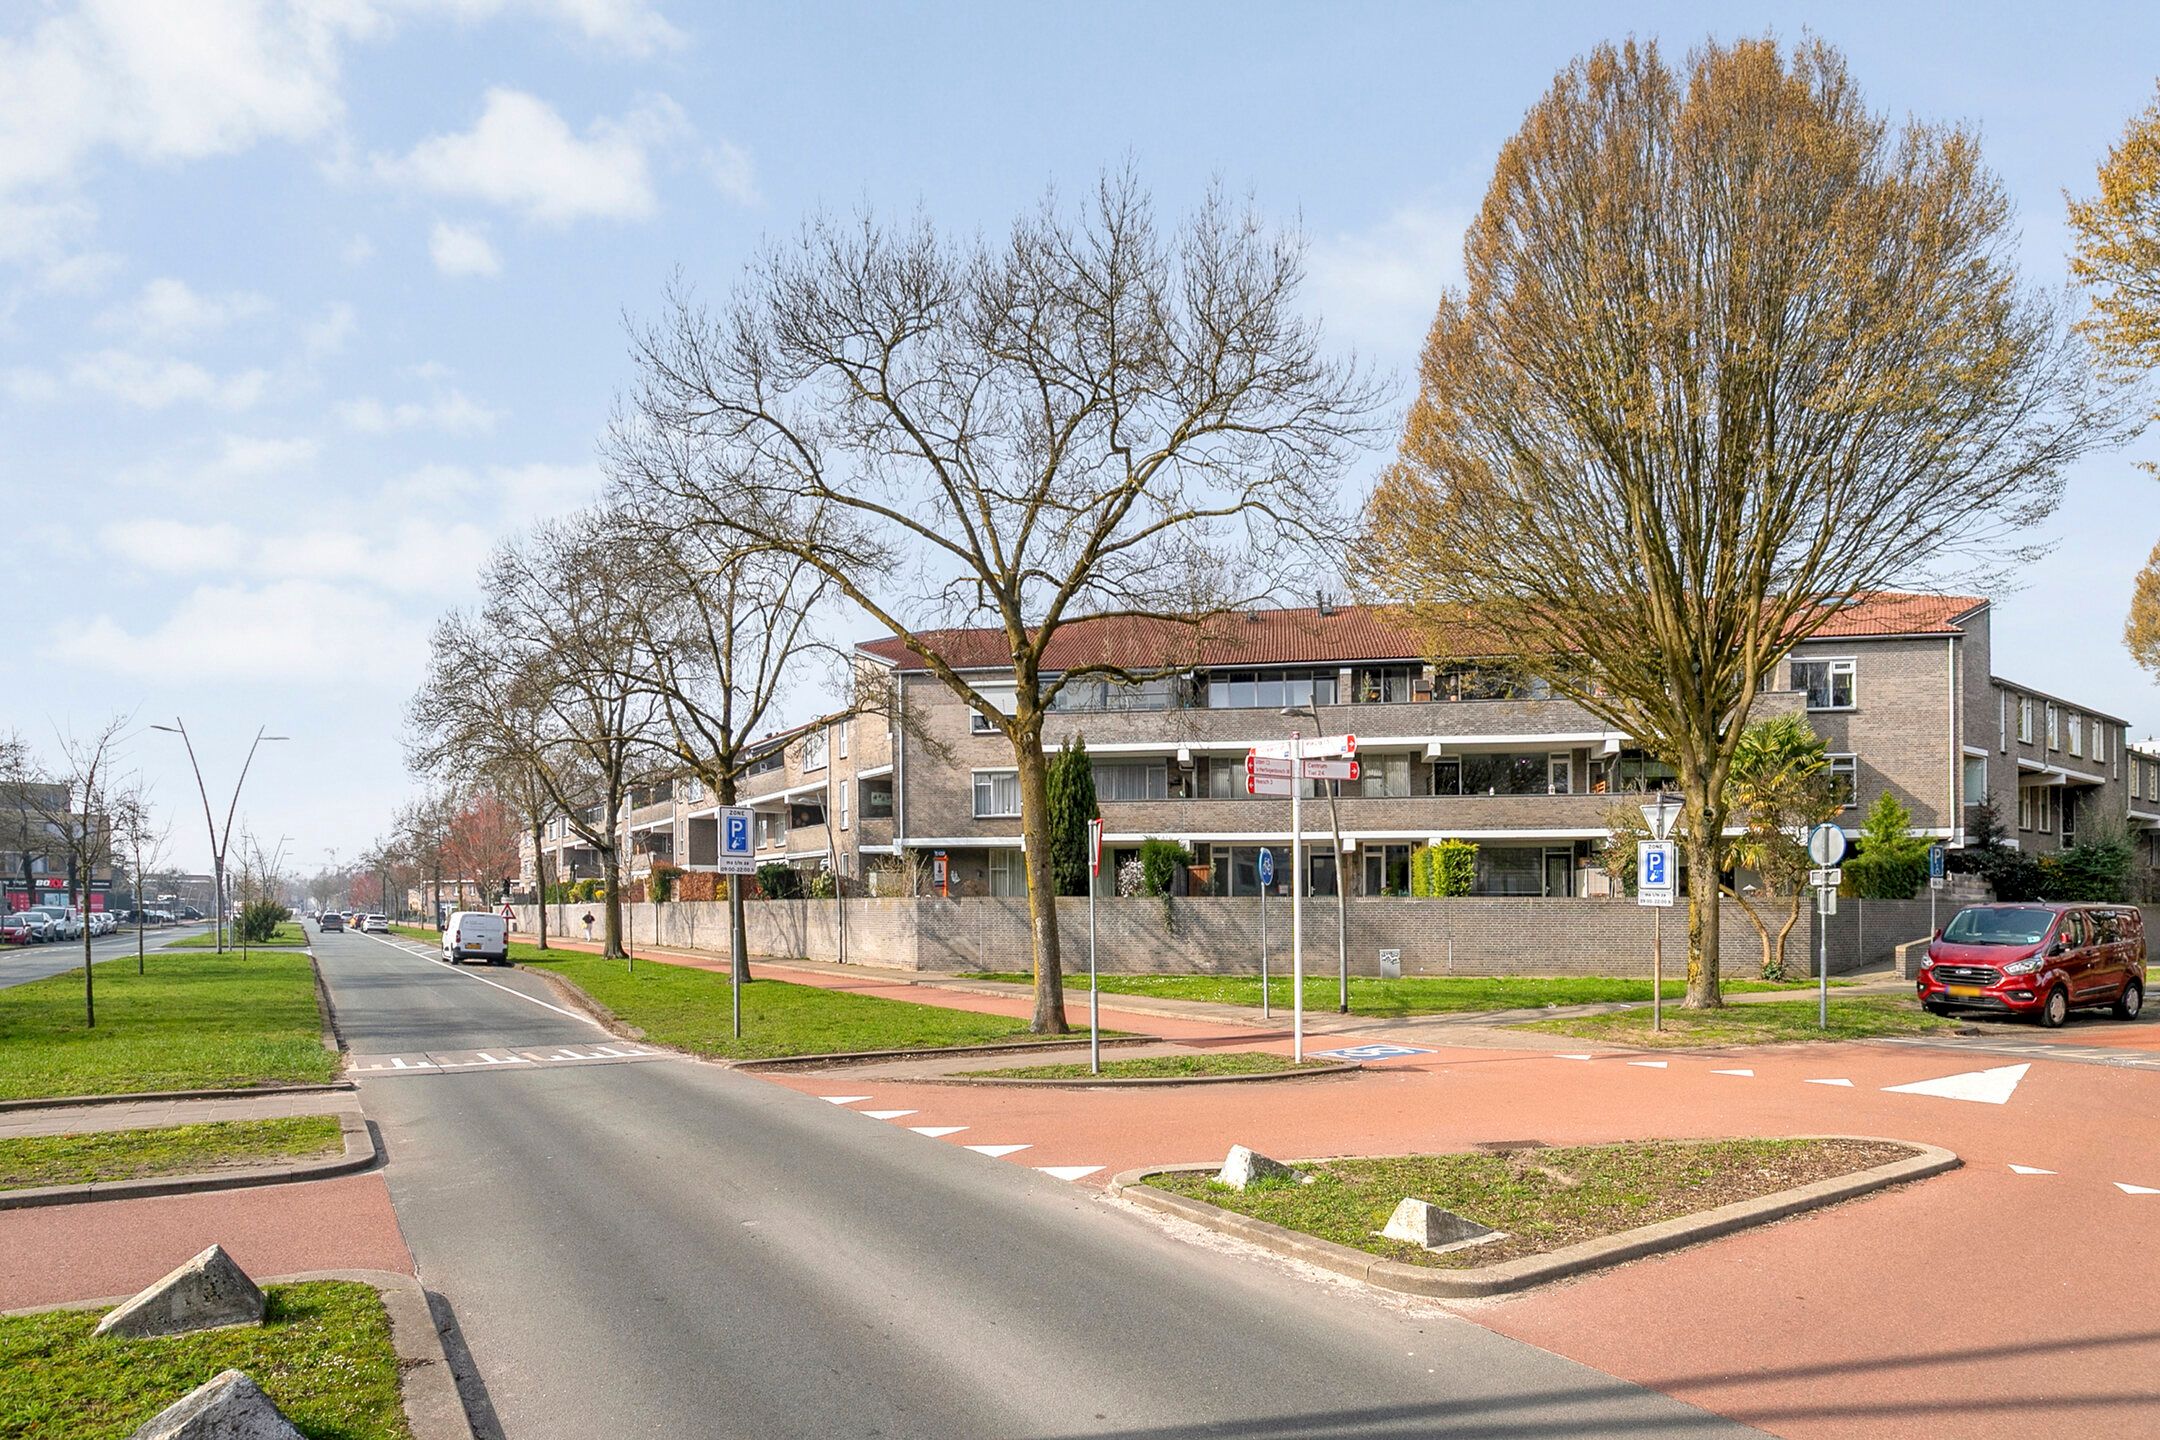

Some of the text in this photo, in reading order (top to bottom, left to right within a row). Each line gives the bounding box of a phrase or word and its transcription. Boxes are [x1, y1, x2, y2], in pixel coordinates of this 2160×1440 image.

[731, 820, 743, 838] P
[1650, 853, 1661, 871] P
[1934, 848, 1942, 864] P
[35, 877, 70, 889] BOXXE
